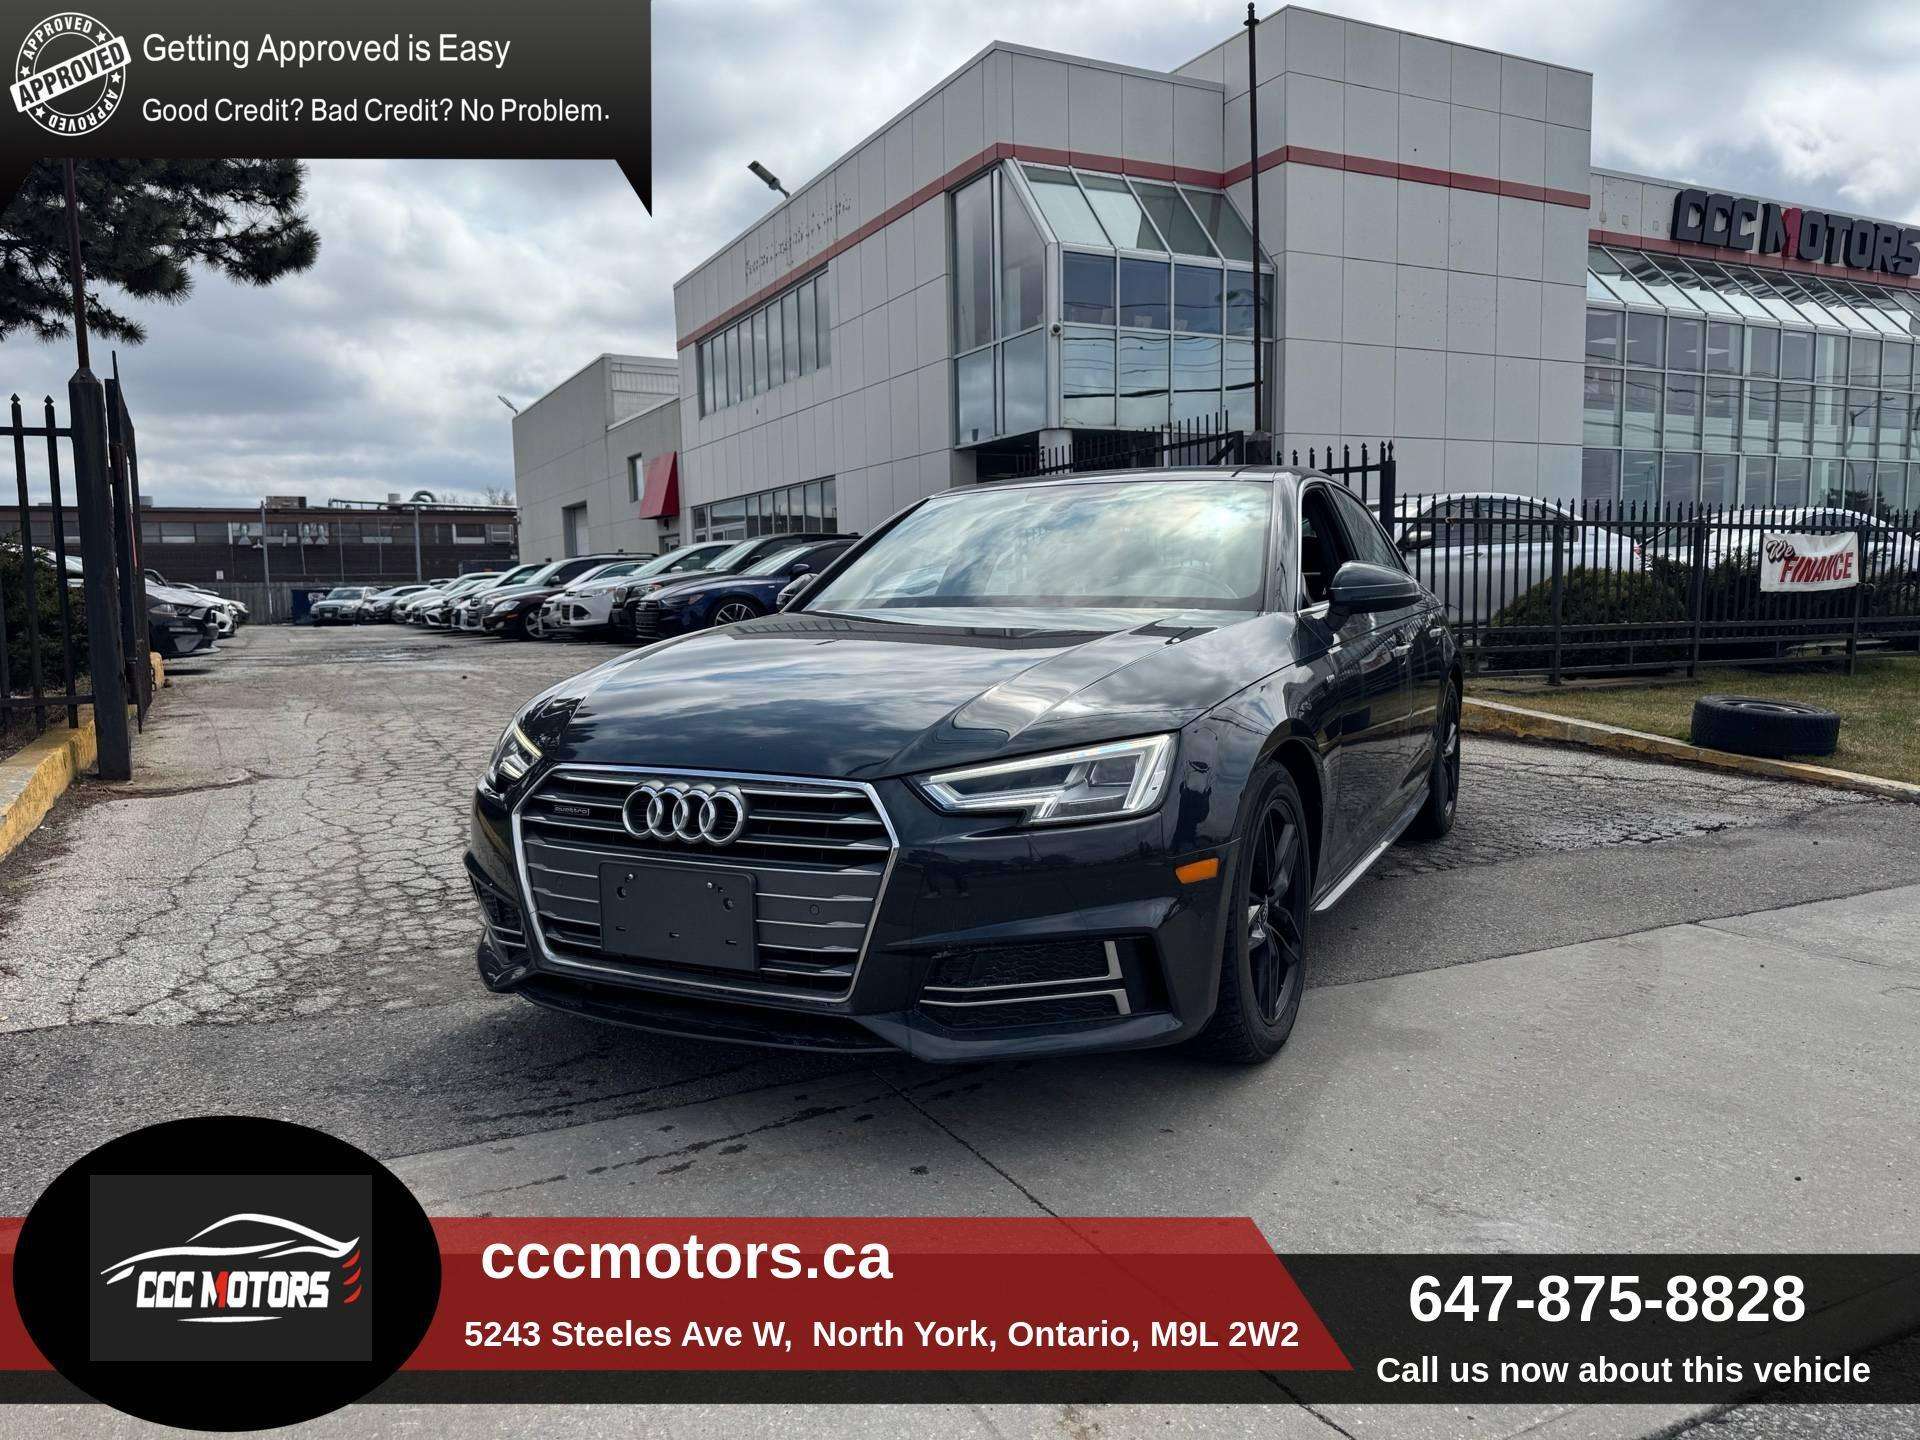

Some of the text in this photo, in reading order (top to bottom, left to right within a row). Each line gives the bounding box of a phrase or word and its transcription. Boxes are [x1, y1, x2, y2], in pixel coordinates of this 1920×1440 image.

[1670, 188, 1920, 276] CCC MOTORS
[1765, 540, 1796, 564] We
[1779, 552, 1853, 582] FINANCE
